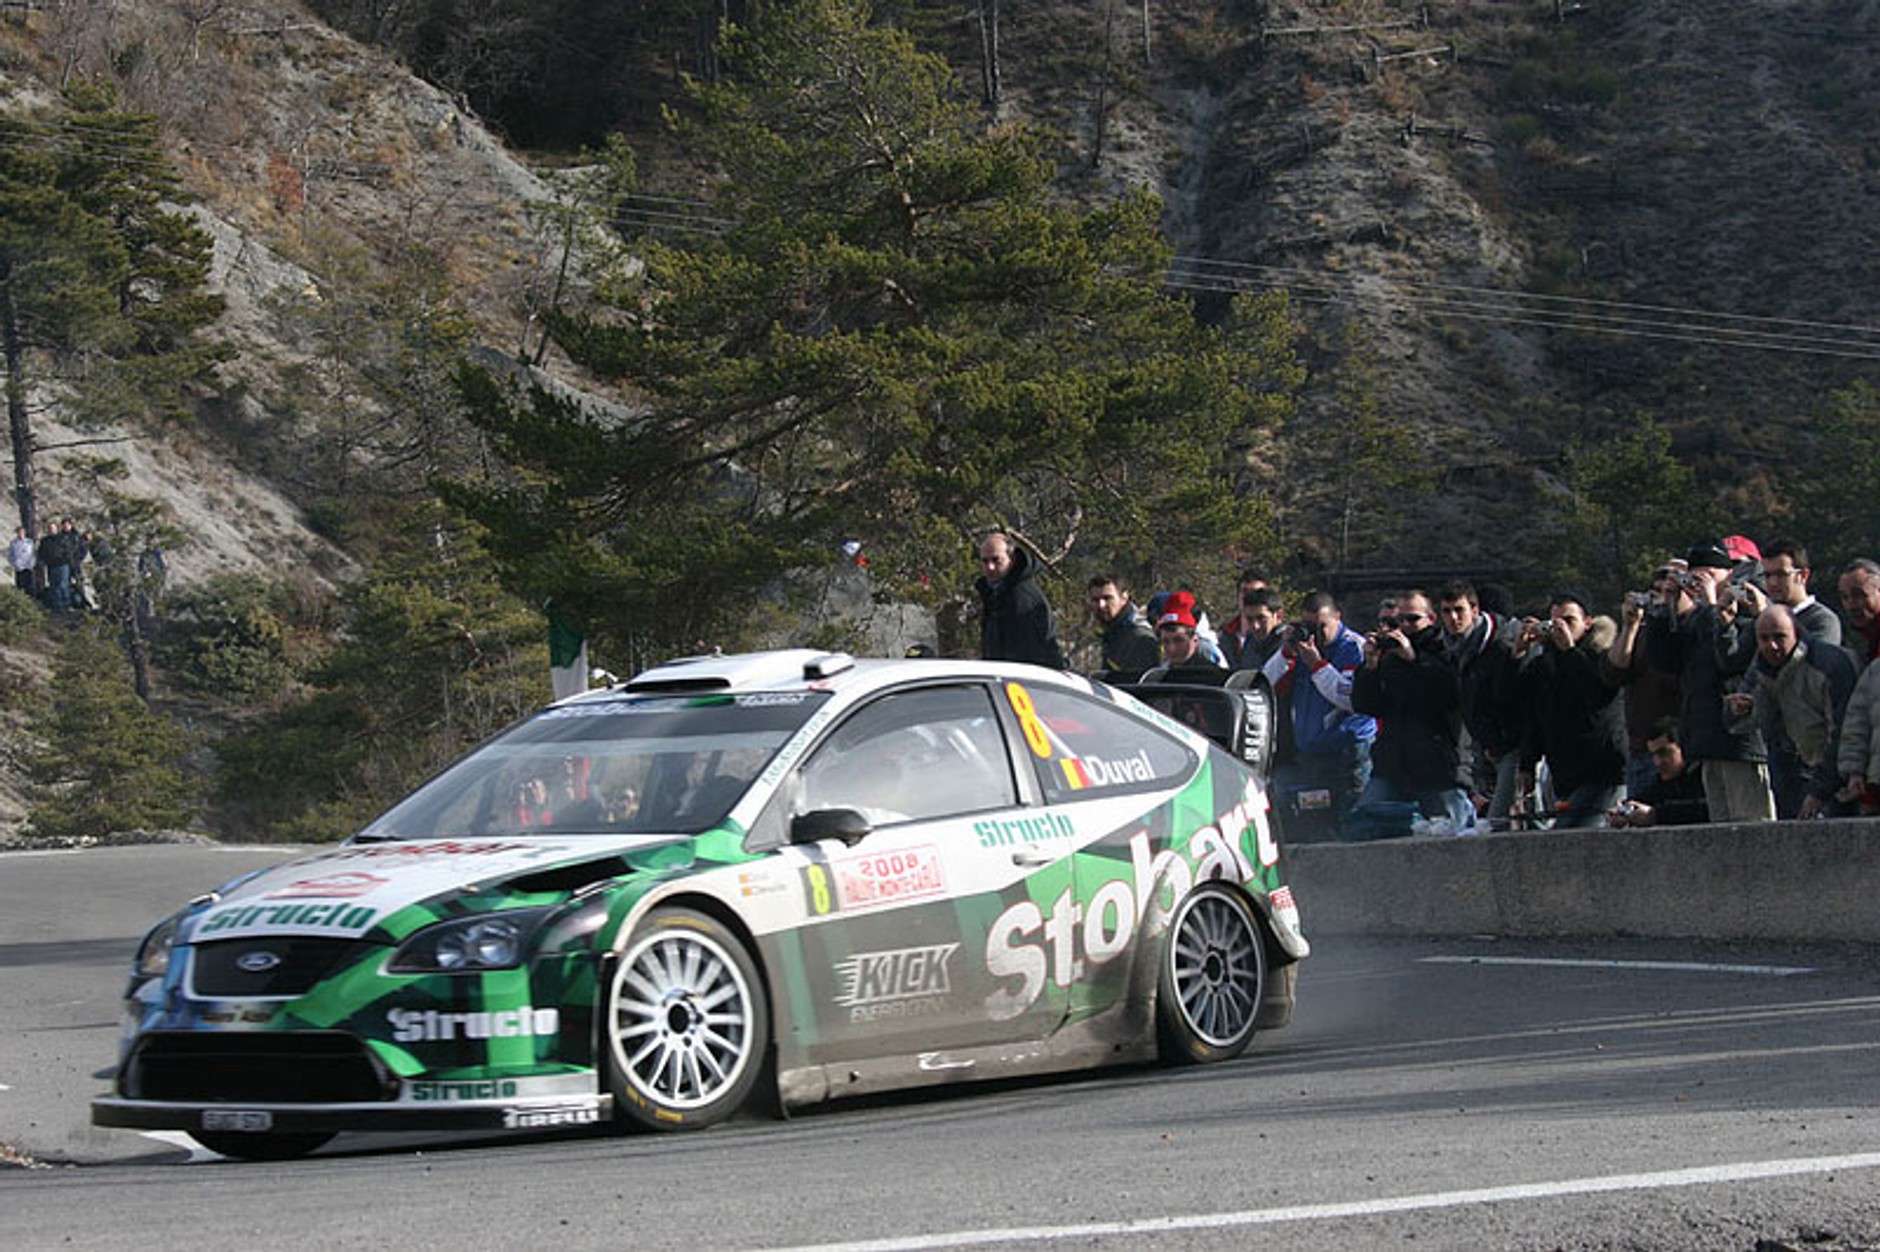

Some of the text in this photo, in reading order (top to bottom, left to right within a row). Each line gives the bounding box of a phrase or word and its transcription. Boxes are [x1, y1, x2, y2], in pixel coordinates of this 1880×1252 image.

[1005, 681, 1053, 760] 8
[1085, 748, 1156, 788] Duval
[807, 863, 831, 916] 8
[858, 852, 919, 878] 2008
[984, 774, 1279, 1021] Stobart
[848, 943, 959, 1002] KICK
